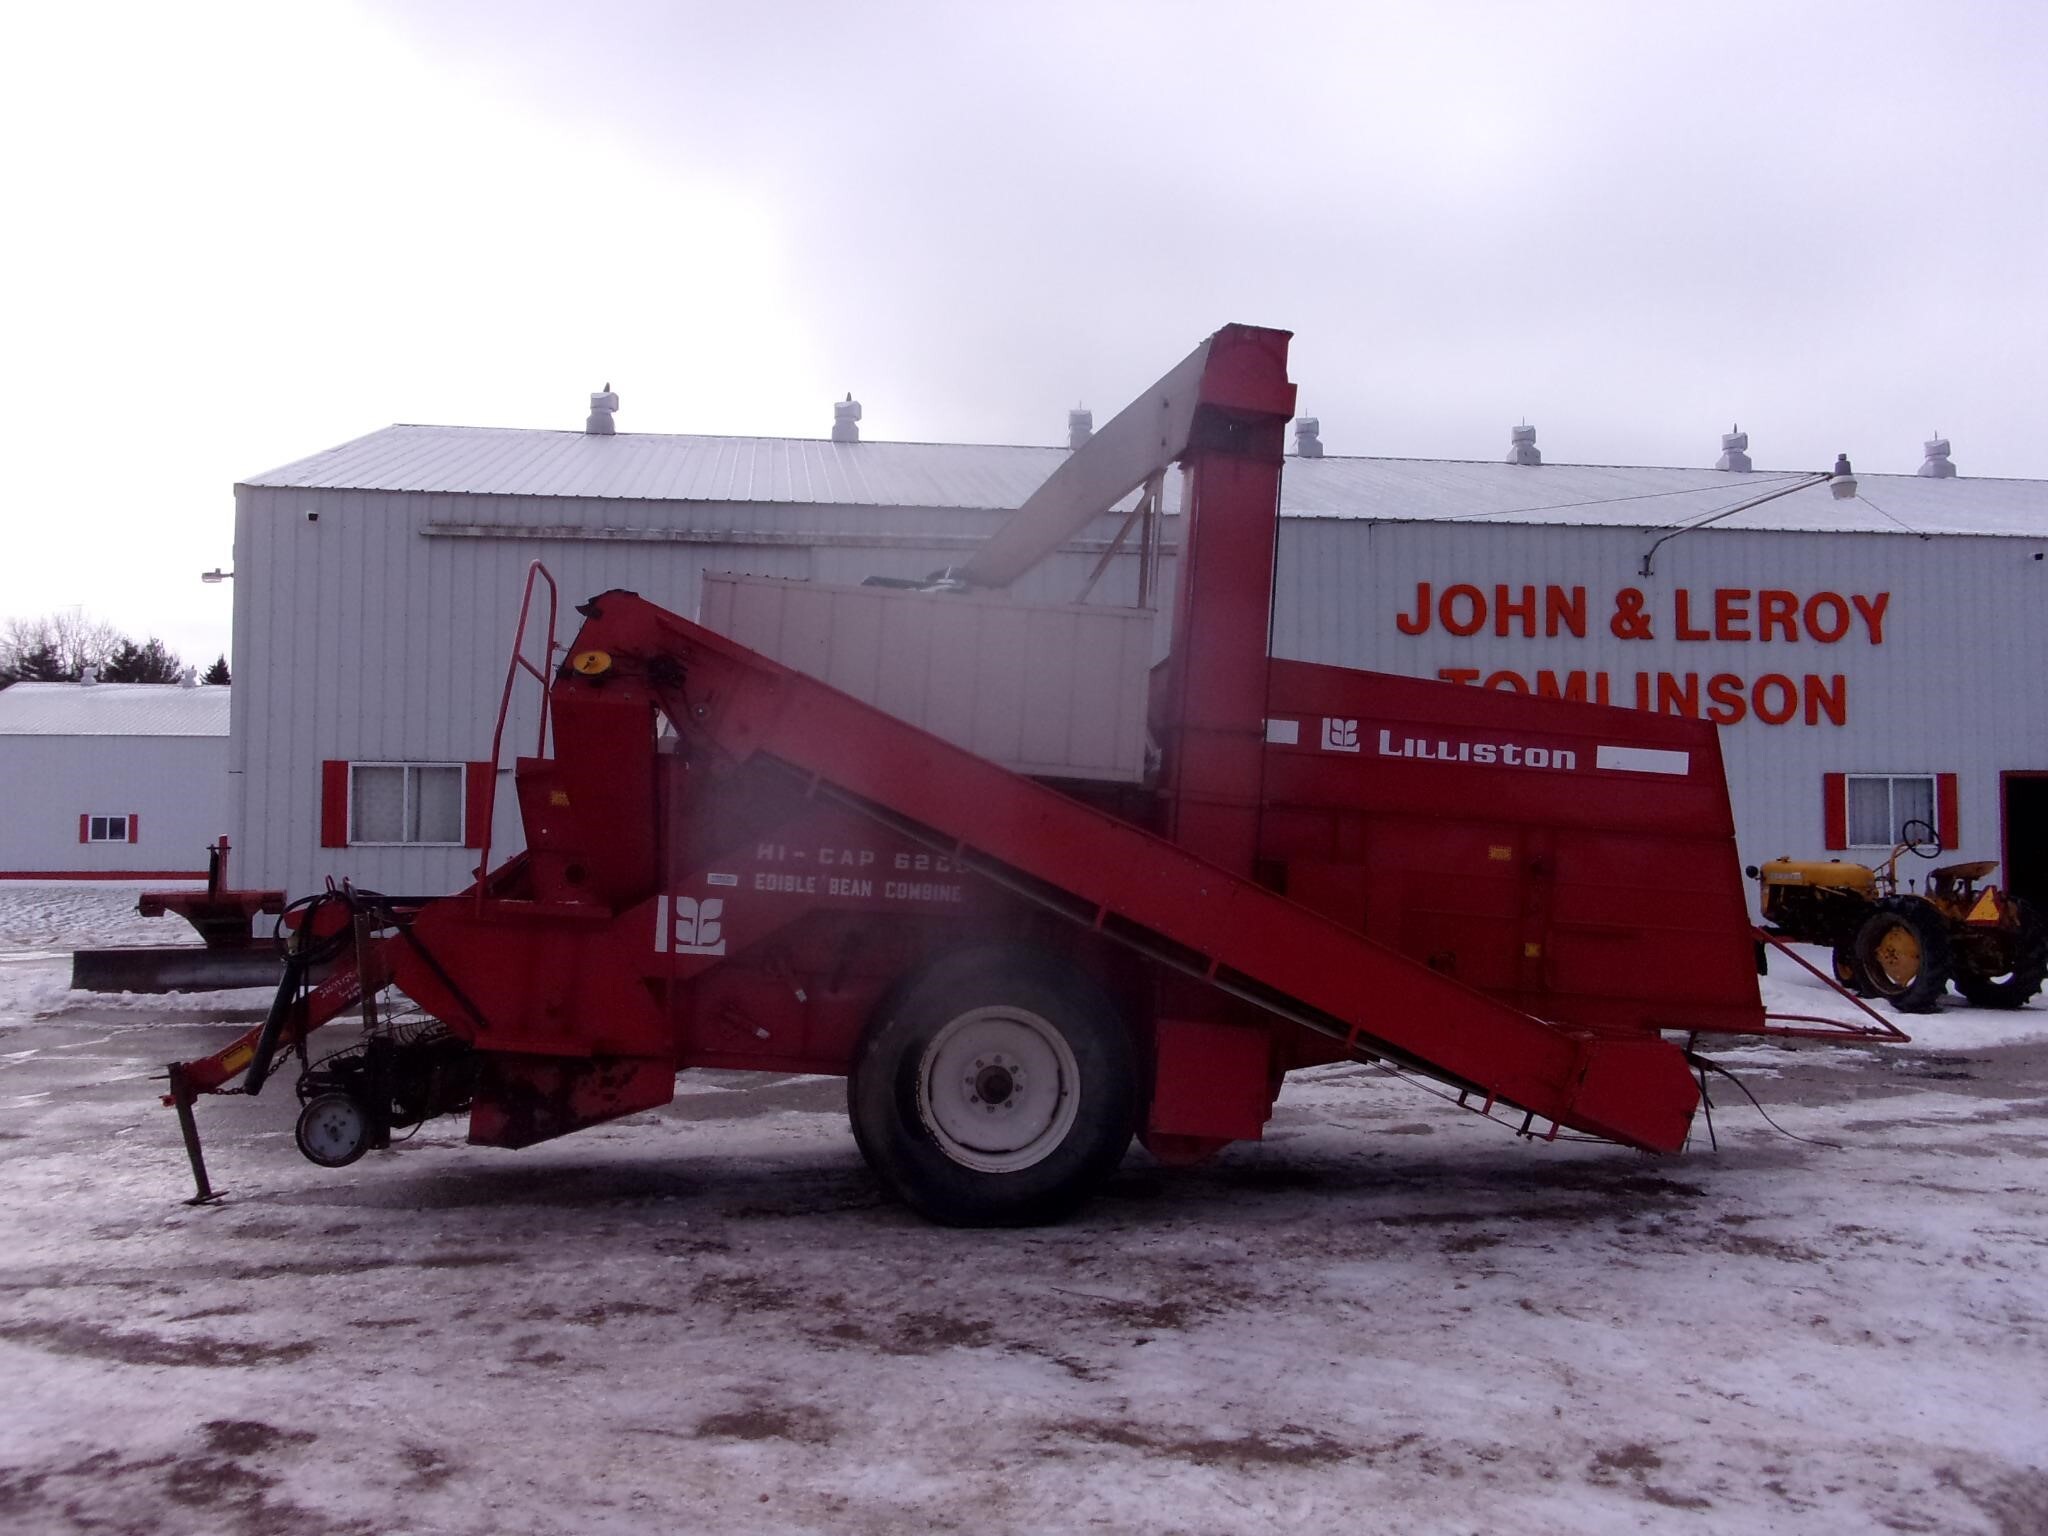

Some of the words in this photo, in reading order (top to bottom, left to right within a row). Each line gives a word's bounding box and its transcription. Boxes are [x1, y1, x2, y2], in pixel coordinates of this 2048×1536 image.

[1396, 582, 1587, 637] JOHN
[1610, 587, 1654, 641] &
[1674, 588, 1890, 645] LEROY
[1438, 668, 1848, 727] MINSON
[755, 873, 816, 894] EDIBLE
[829, 877, 872, 898] BEAN
[884, 881, 963, 902] COMBINE
